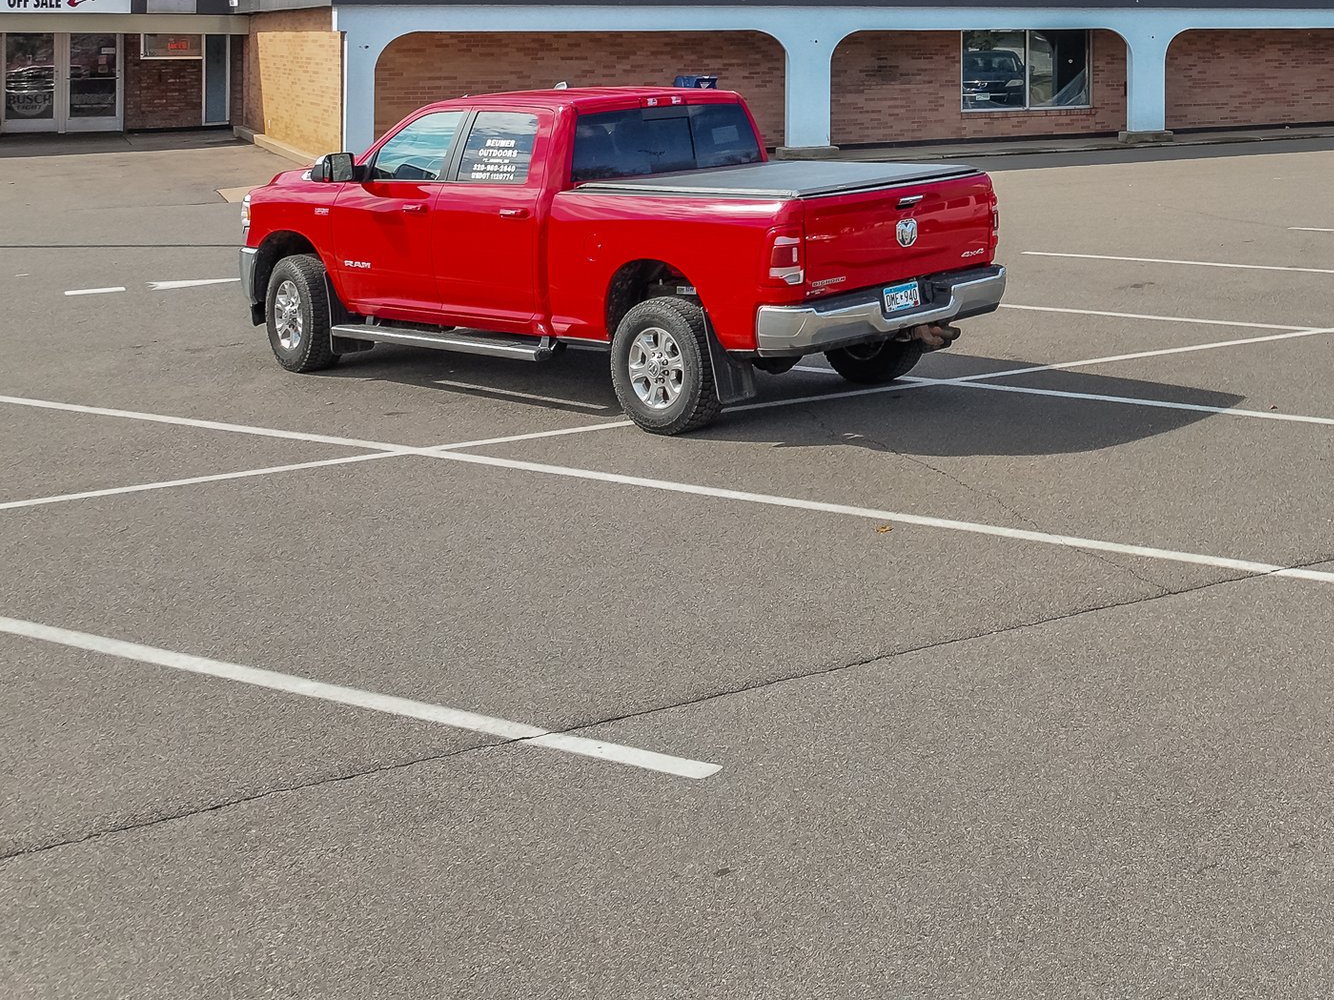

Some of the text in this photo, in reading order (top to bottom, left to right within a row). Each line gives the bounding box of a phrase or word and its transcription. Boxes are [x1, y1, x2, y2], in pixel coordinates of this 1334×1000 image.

[7, 94, 52, 105] BUSCH
[478, 149, 518, 158] OUTDOORS
[343, 260, 371, 269] RAM
[885, 292, 901, 308] DME
[904, 288, 918, 303] 940
